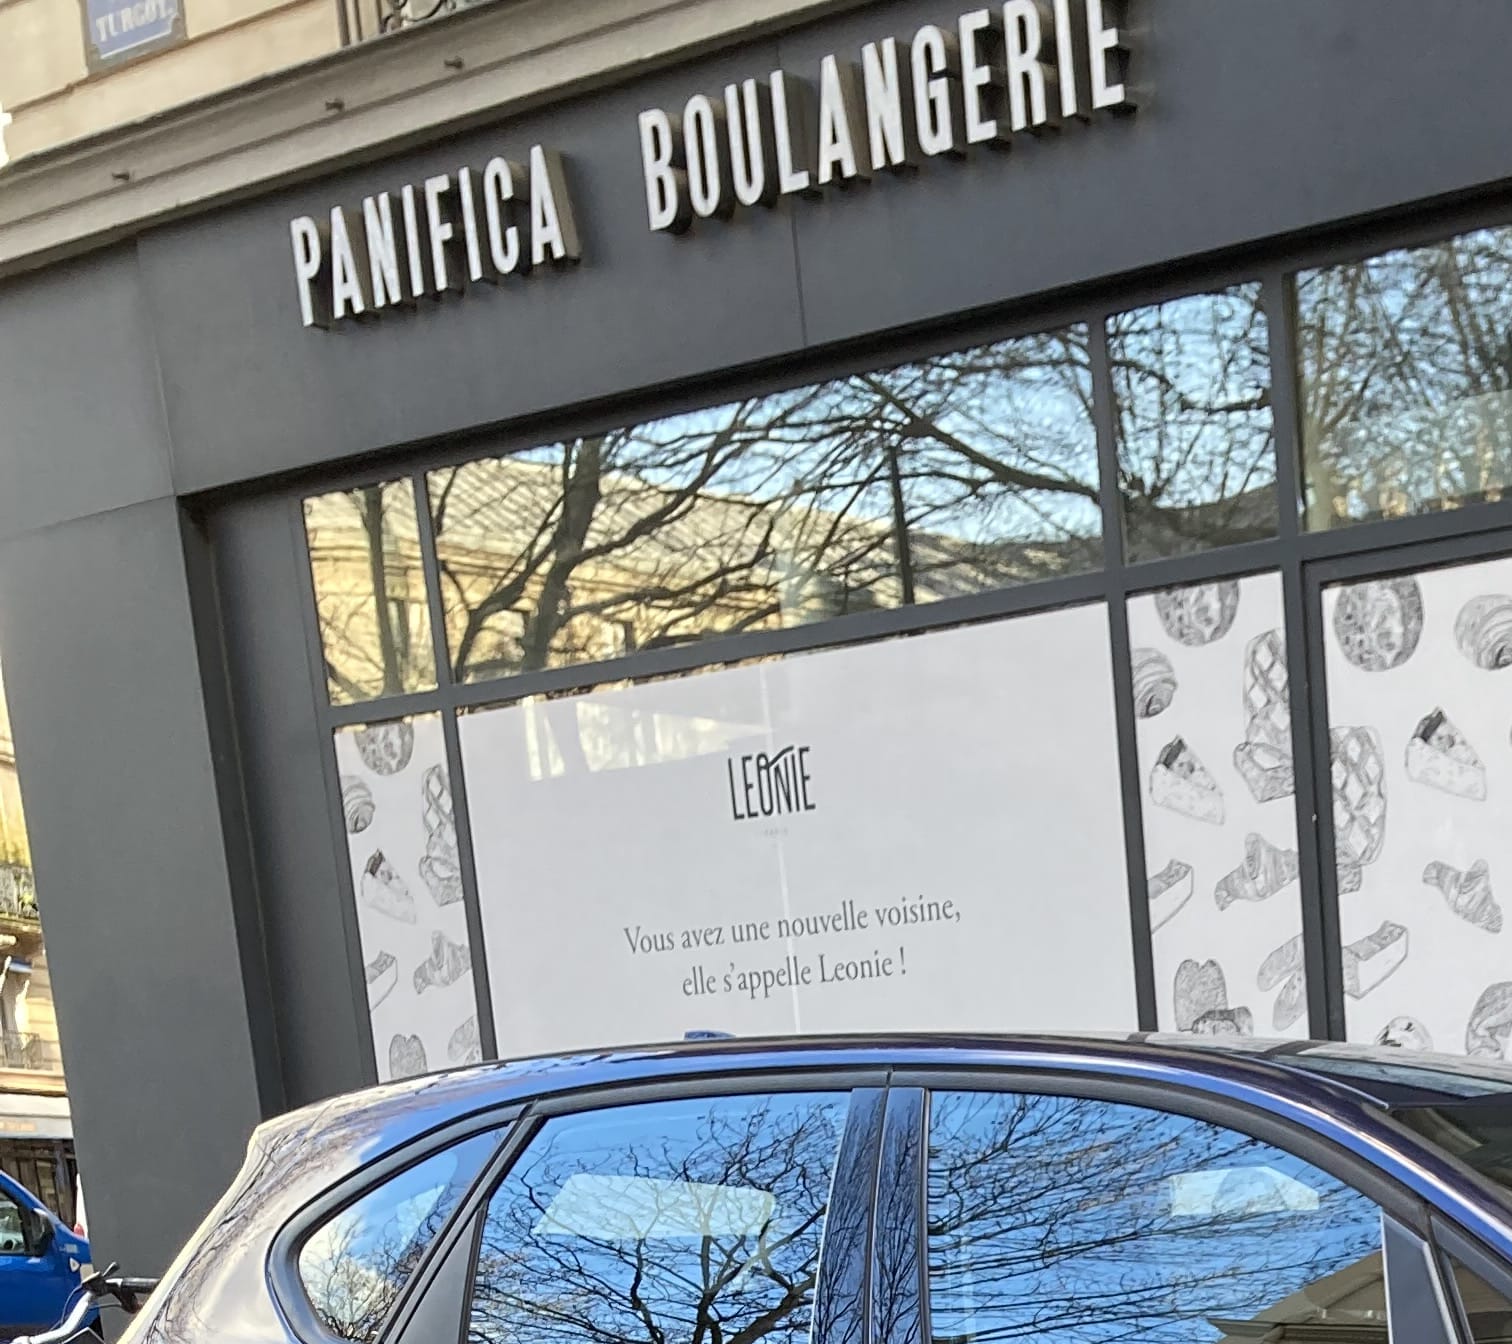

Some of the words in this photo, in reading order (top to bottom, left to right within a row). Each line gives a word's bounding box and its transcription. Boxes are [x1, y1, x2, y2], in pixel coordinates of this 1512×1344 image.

[290, 144, 566, 327] PANIFICA
[638, 0, 1125, 231] BOULANGERIE
[624, 926, 675, 954] Vous
[681, 926, 725, 949] avez
[731, 920, 770, 943] une
[777, 899, 868, 938] nouvelle
[875, 894, 961, 927] voisine,
[682, 965, 717, 997] elle
[818, 949, 894, 983] Leonie
